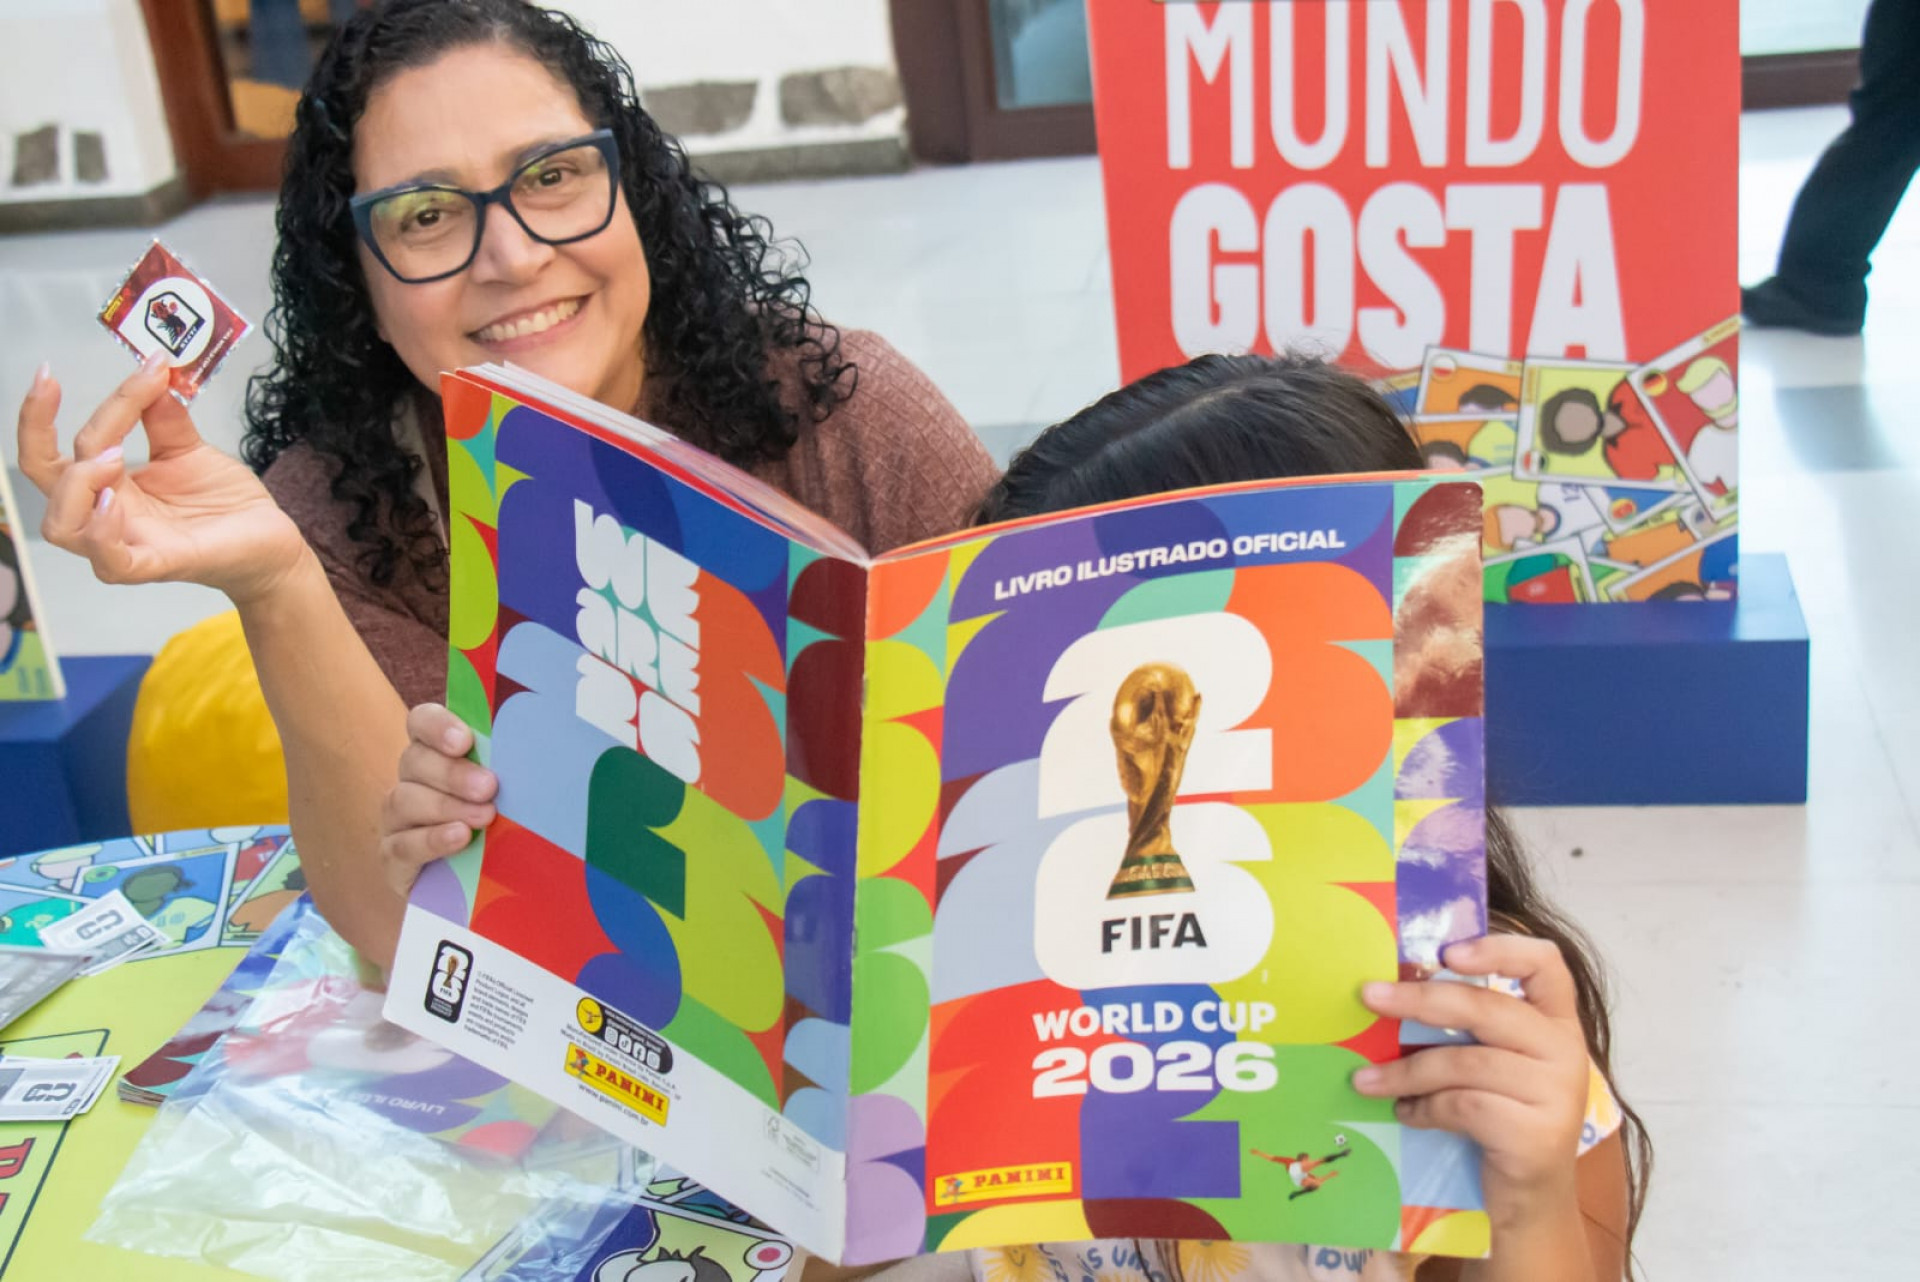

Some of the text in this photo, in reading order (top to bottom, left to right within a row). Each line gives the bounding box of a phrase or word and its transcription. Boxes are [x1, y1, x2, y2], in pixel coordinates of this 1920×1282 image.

[1164, 0, 1645, 170] MUNDO
[1169, 182, 1628, 371] GOSTA
[994, 529, 1346, 600] LIVRO ILUSTRADO OFICIAL
[1101, 912, 1208, 953] FIFA
[1032, 1001, 1277, 1042] WORLD CUP
[595, 1062, 665, 1112] PANINI
[1031, 1041, 1279, 1100] 2026
[974, 1166, 1066, 1188] PANINI
